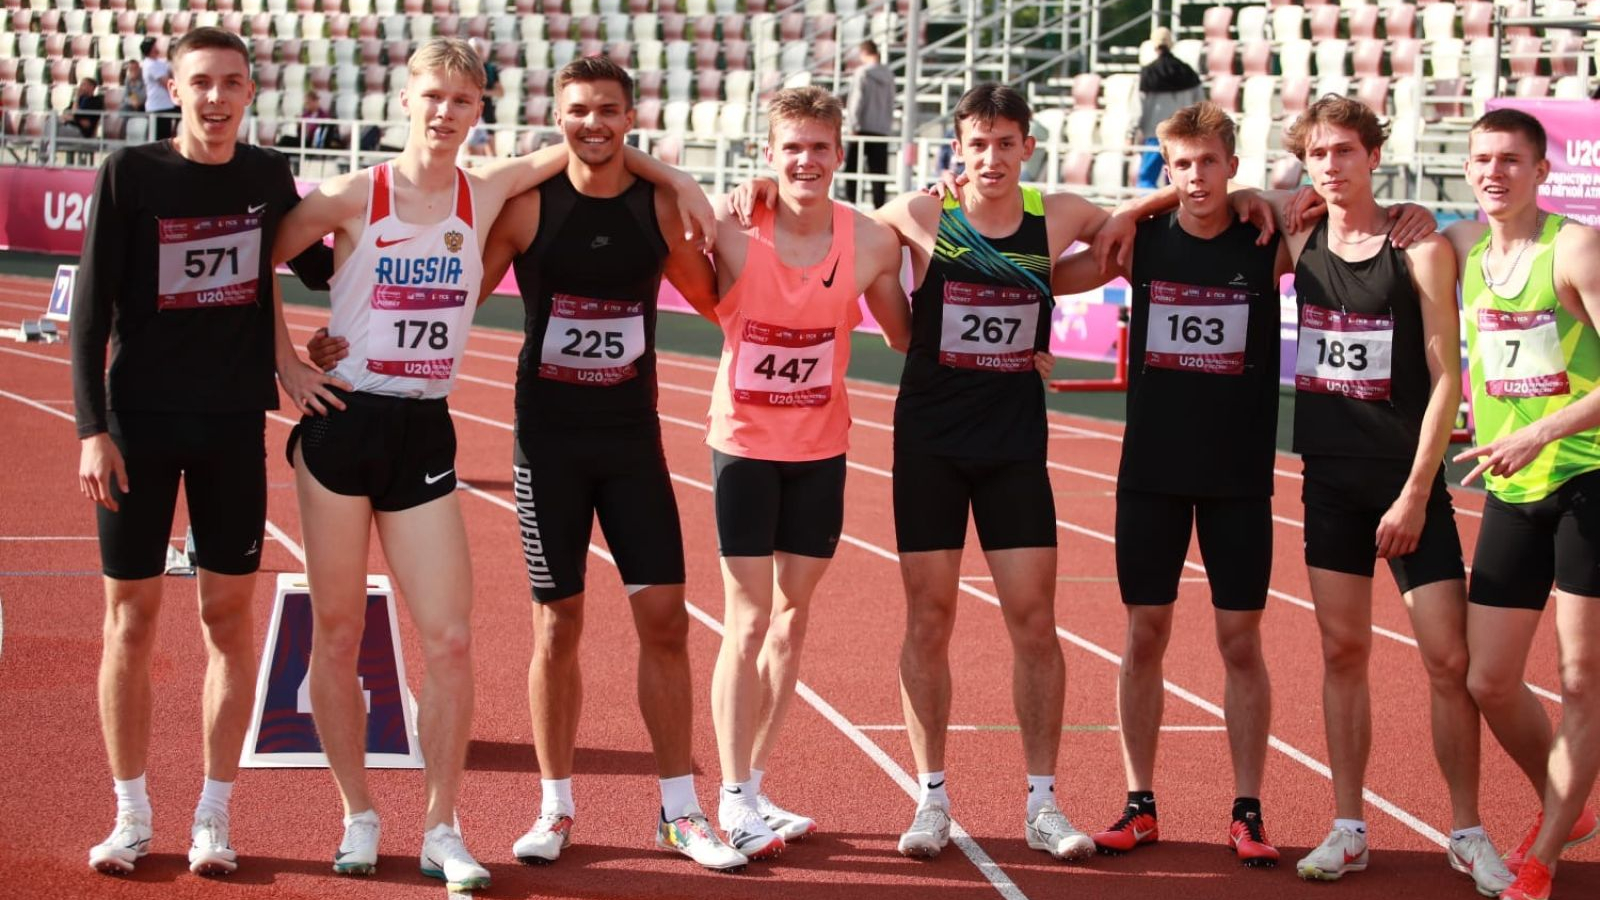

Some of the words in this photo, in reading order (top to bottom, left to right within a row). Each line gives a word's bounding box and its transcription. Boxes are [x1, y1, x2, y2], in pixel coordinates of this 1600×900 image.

[184, 247, 238, 278] 571
[375, 257, 463, 284] RUSSIA
[56, 276, 70, 310] 7
[197, 290, 224, 303] U20
[394, 319, 449, 350] 178
[561, 328, 625, 359] 225
[961, 314, 1022, 345] 267
[1167, 314, 1225, 345] 163
[976, 356, 1001, 367] U20
[1180, 355, 1204, 368] U20
[1316, 338, 1368, 371] 183
[1505, 340, 1521, 368] 7
[404, 363, 431, 375] U20
[577, 370, 603, 382] U20
[754, 354, 819, 383] 447
[769, 393, 793, 404] U20
[1503, 381, 1529, 394] U20
